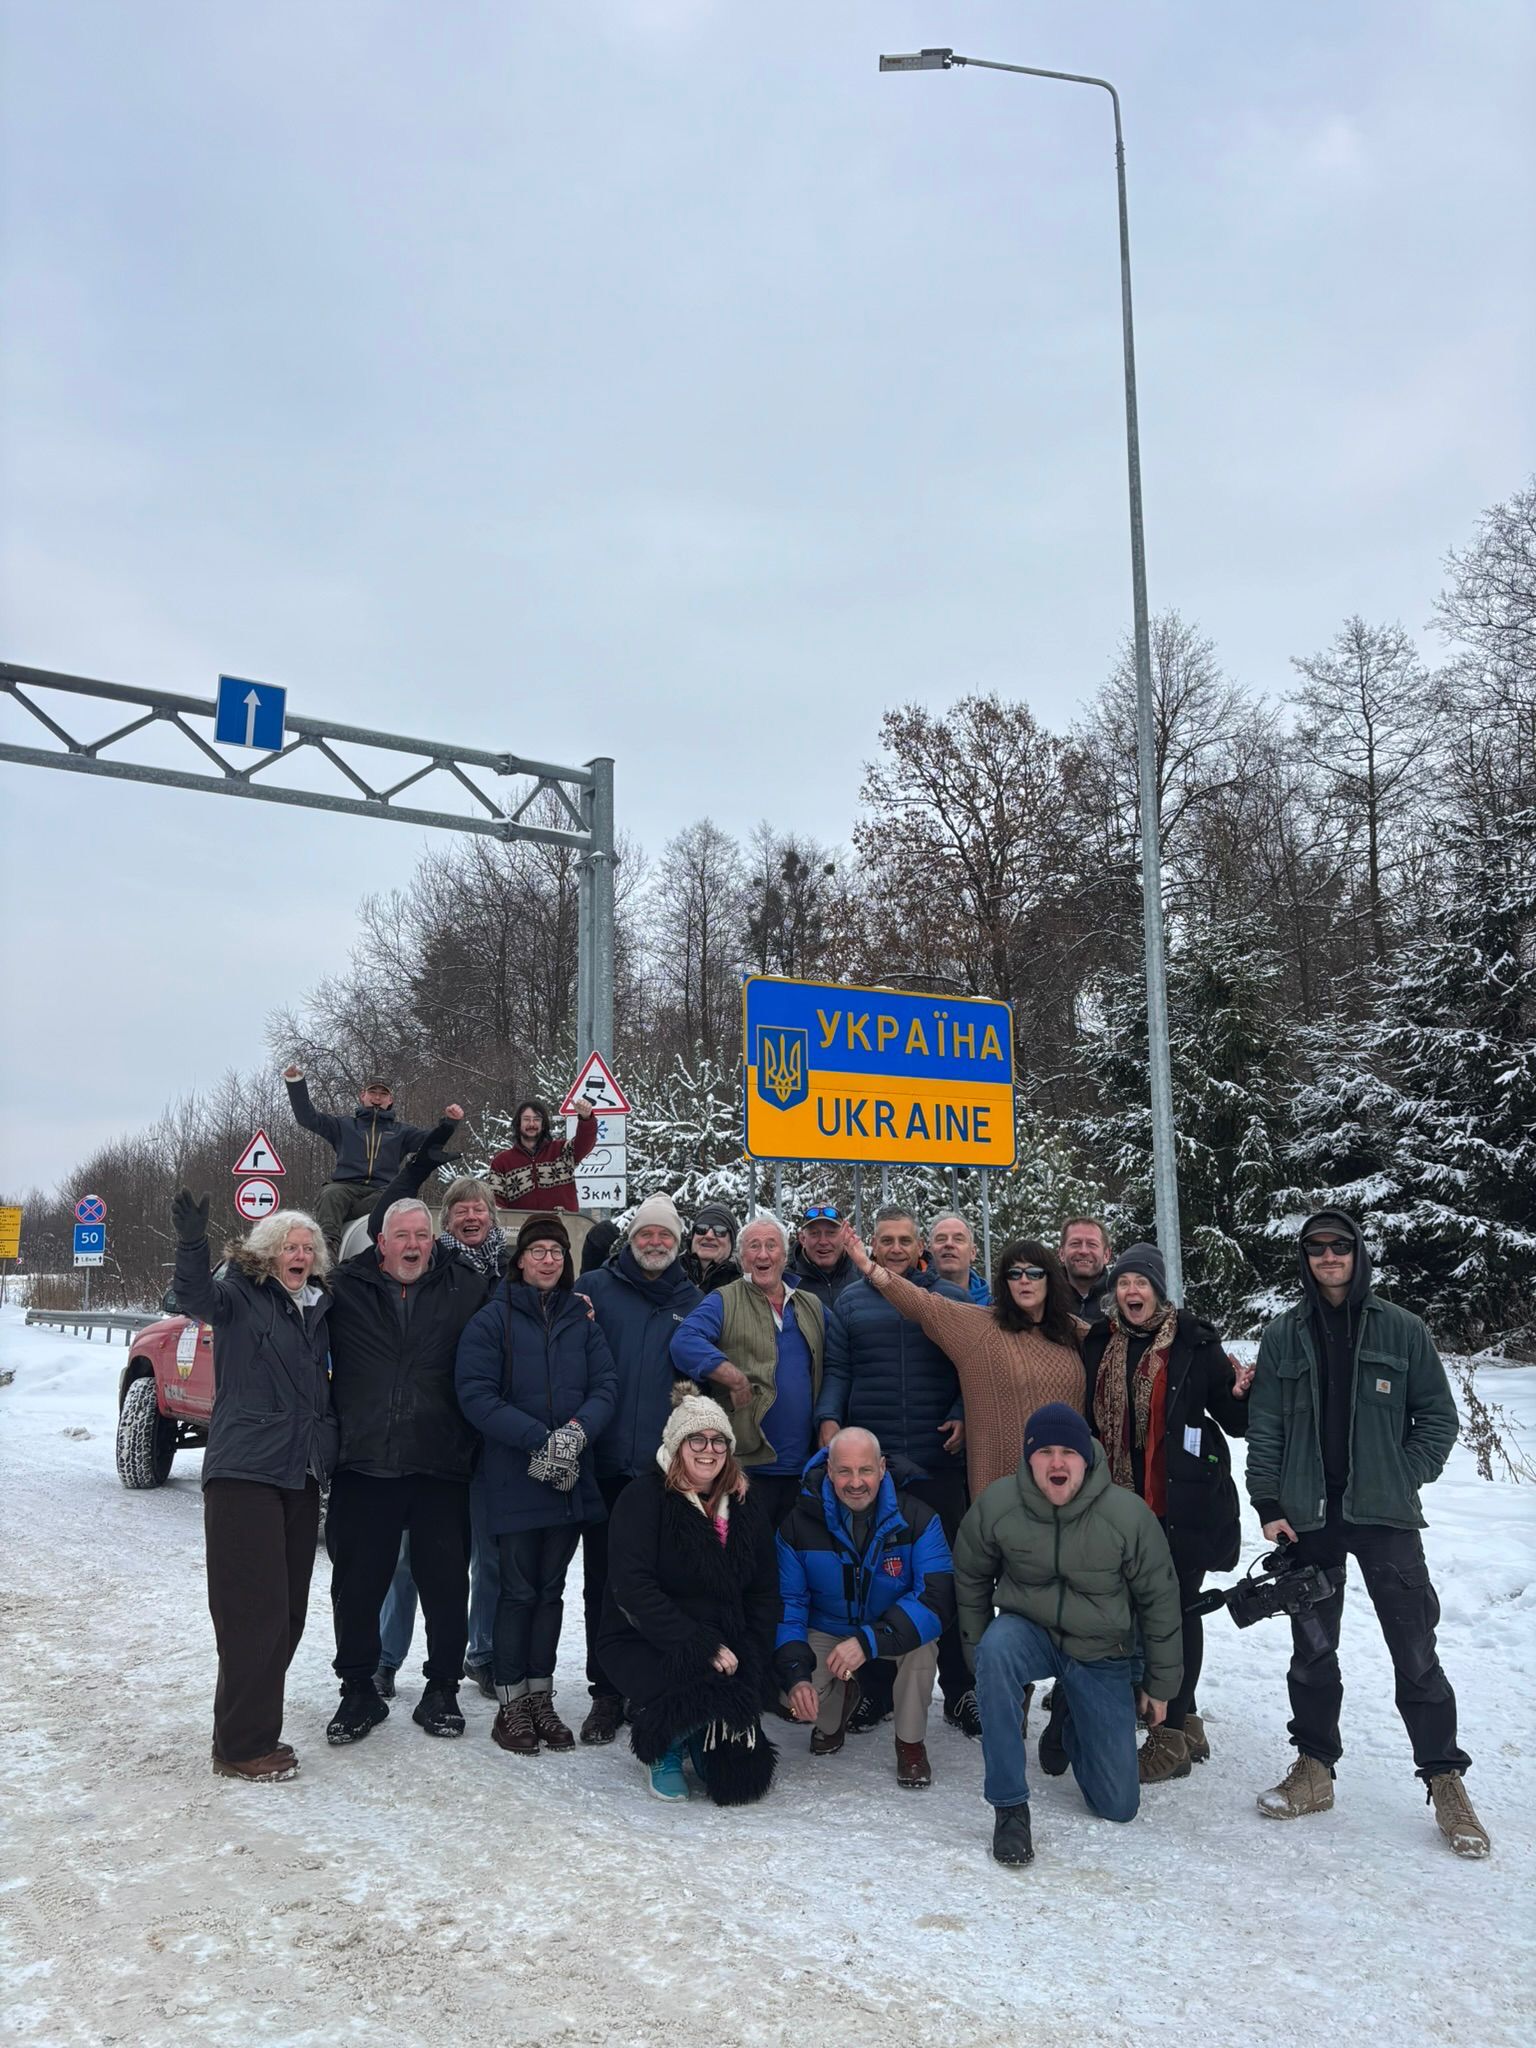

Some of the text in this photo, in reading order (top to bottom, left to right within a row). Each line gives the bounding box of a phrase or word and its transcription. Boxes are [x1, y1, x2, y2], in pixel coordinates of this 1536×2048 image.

[816, 1009, 1004, 1061] УКРАЇНА
[817, 1097, 992, 1143] UKRAINE
[80, 1232, 99, 1244] 50
